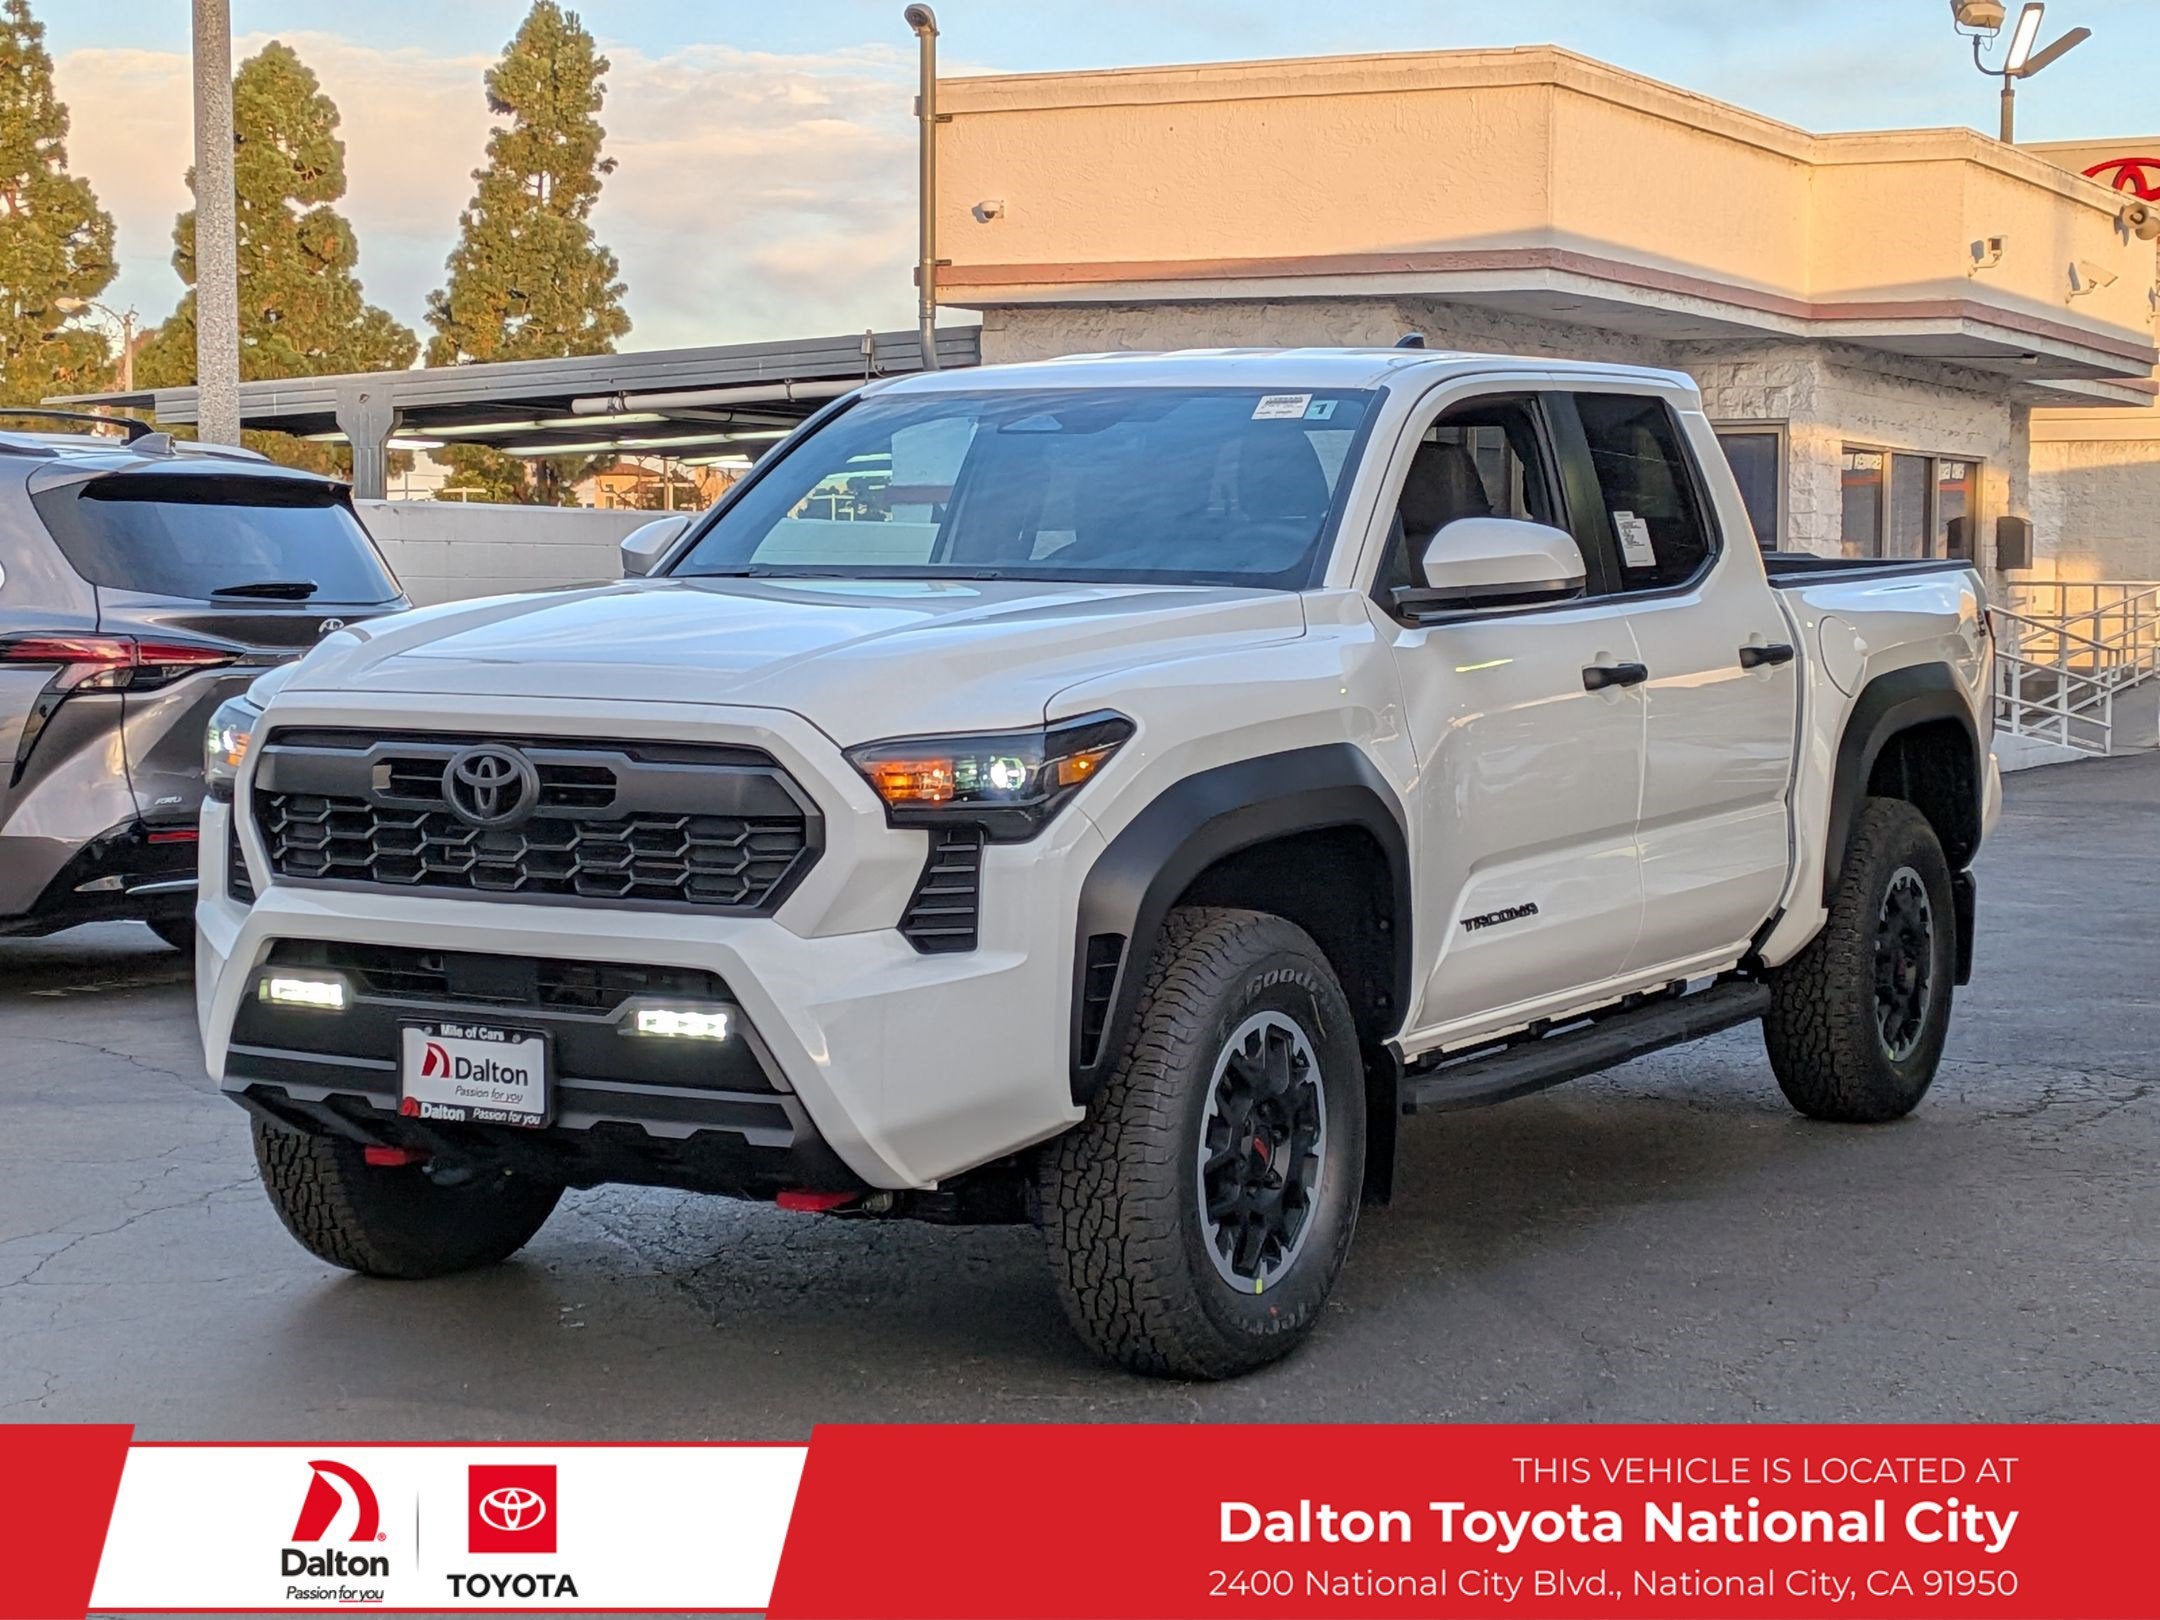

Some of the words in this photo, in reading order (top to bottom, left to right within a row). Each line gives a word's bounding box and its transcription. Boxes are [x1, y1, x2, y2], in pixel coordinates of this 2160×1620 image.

[440, 1024, 463, 1037] Mile
[465, 1026, 478, 1039] of
[479, 1028, 505, 1041] Cars
[455, 1056, 528, 1086] Dalton
[455, 1085, 489, 1098] Passion
[491, 1088, 504, 1101] for
[505, 1093, 524, 1103] you
[420, 1102, 465, 1122] Dalton
[473, 1108, 507, 1122] Passion
[508, 1111, 522, 1123] for
[523, 1115, 541, 1126] you
